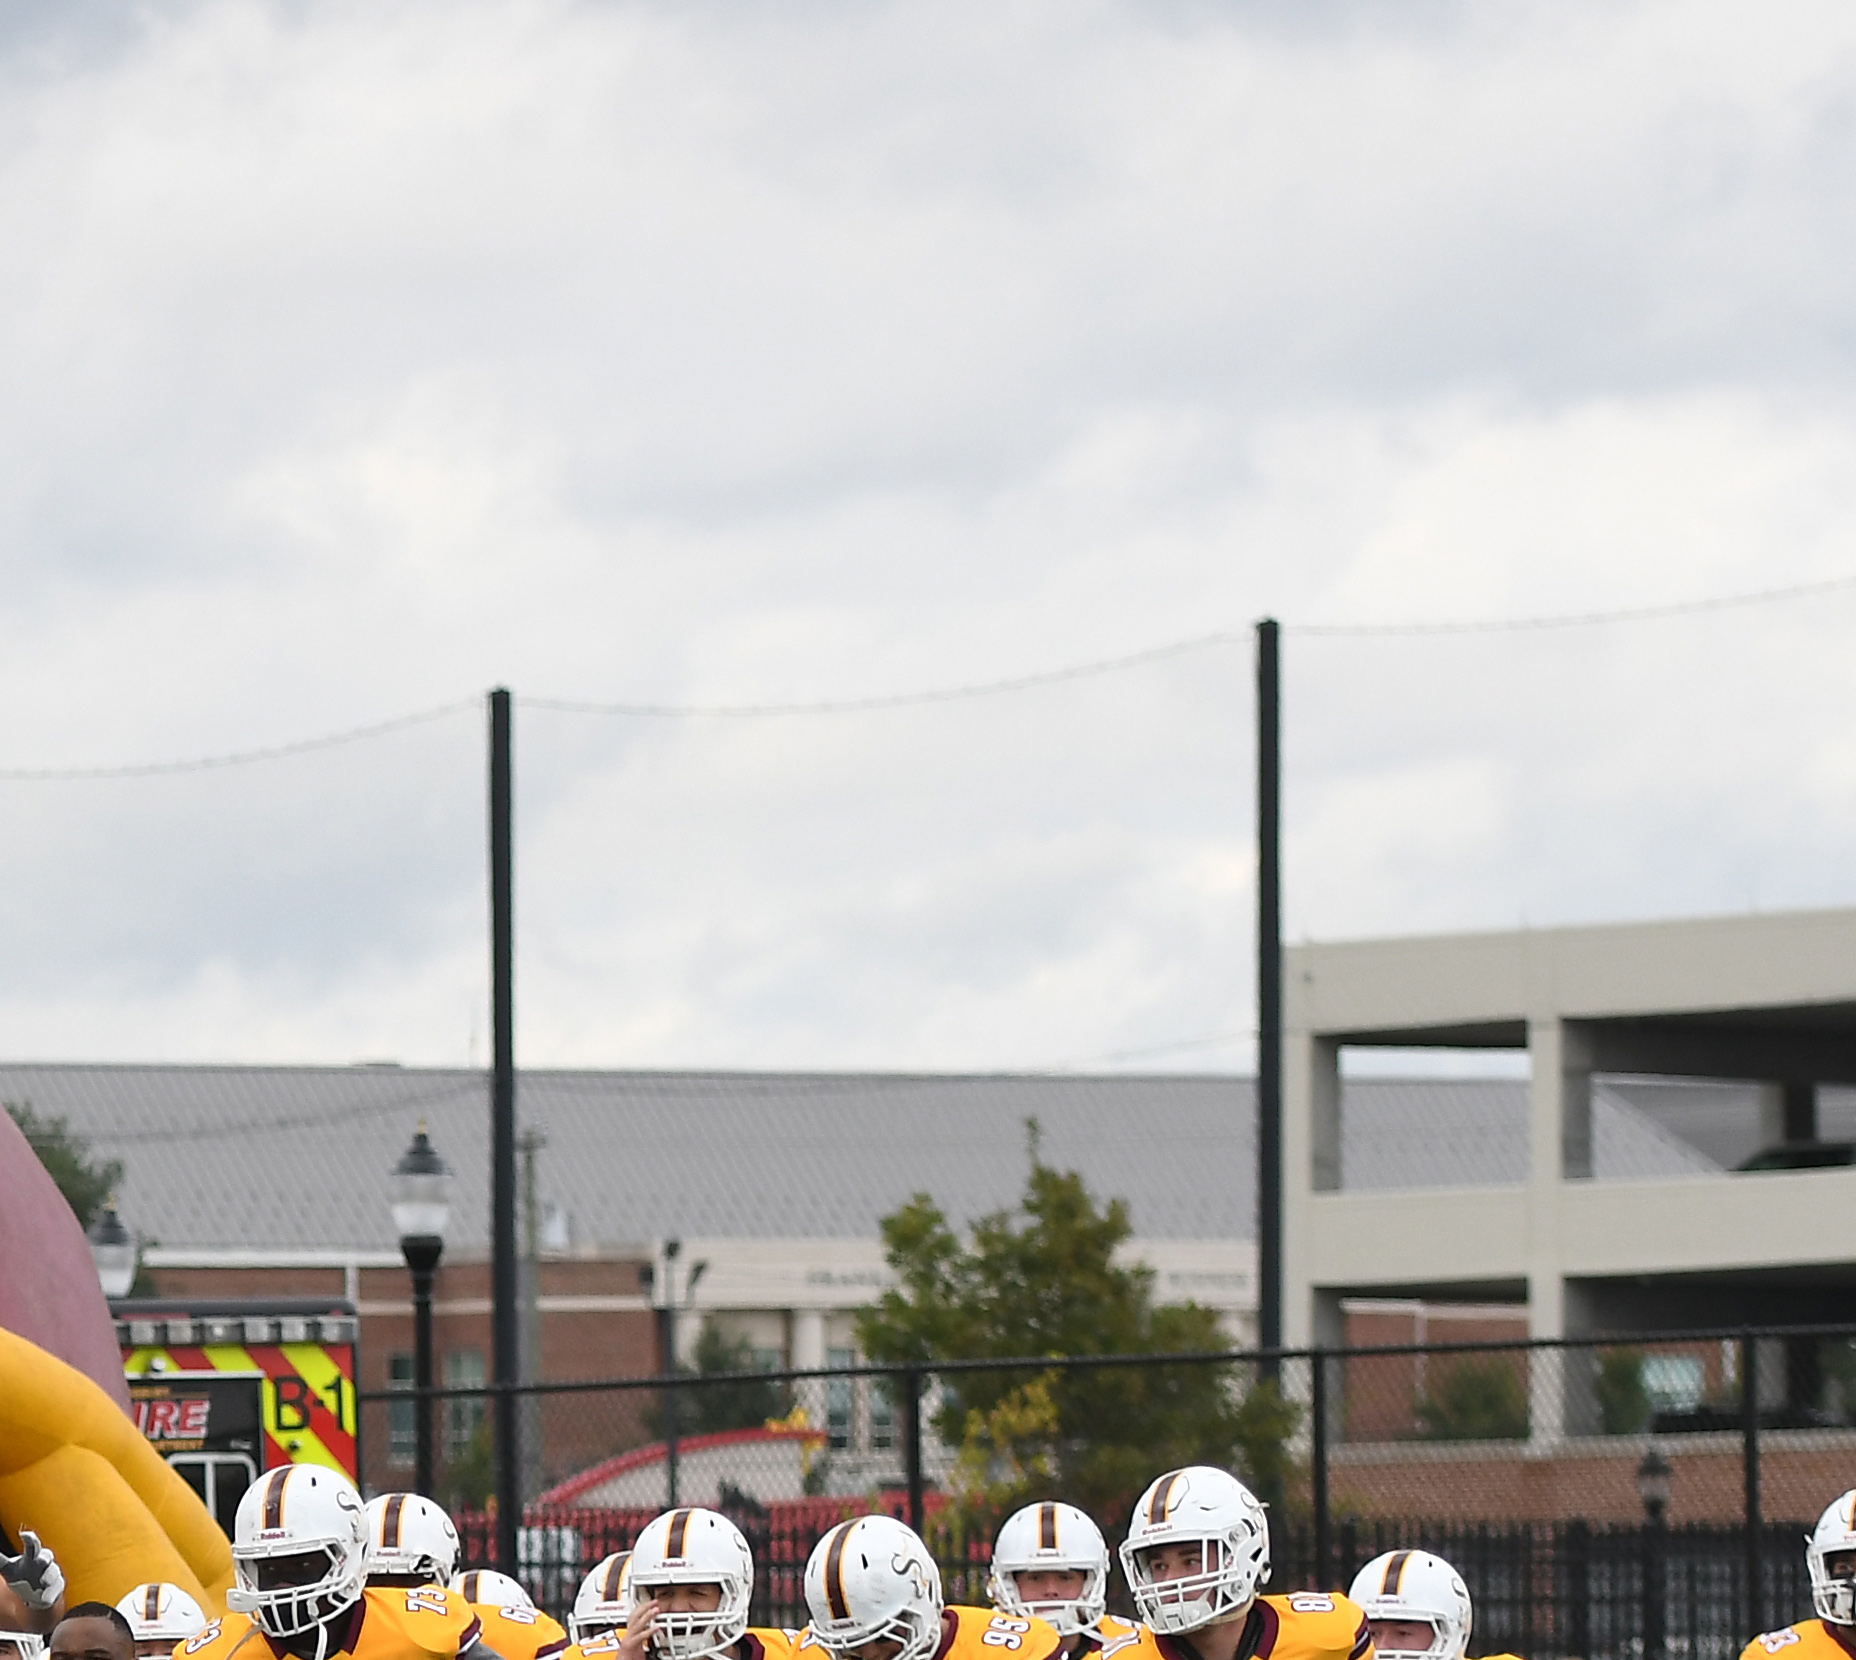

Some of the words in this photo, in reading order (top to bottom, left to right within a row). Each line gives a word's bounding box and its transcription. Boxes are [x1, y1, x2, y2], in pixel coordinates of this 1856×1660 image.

[133, 1400, 210, 1439] IRE
[275, 1374, 345, 1431] B-1
[982, 1616, 1031, 1651] 95
